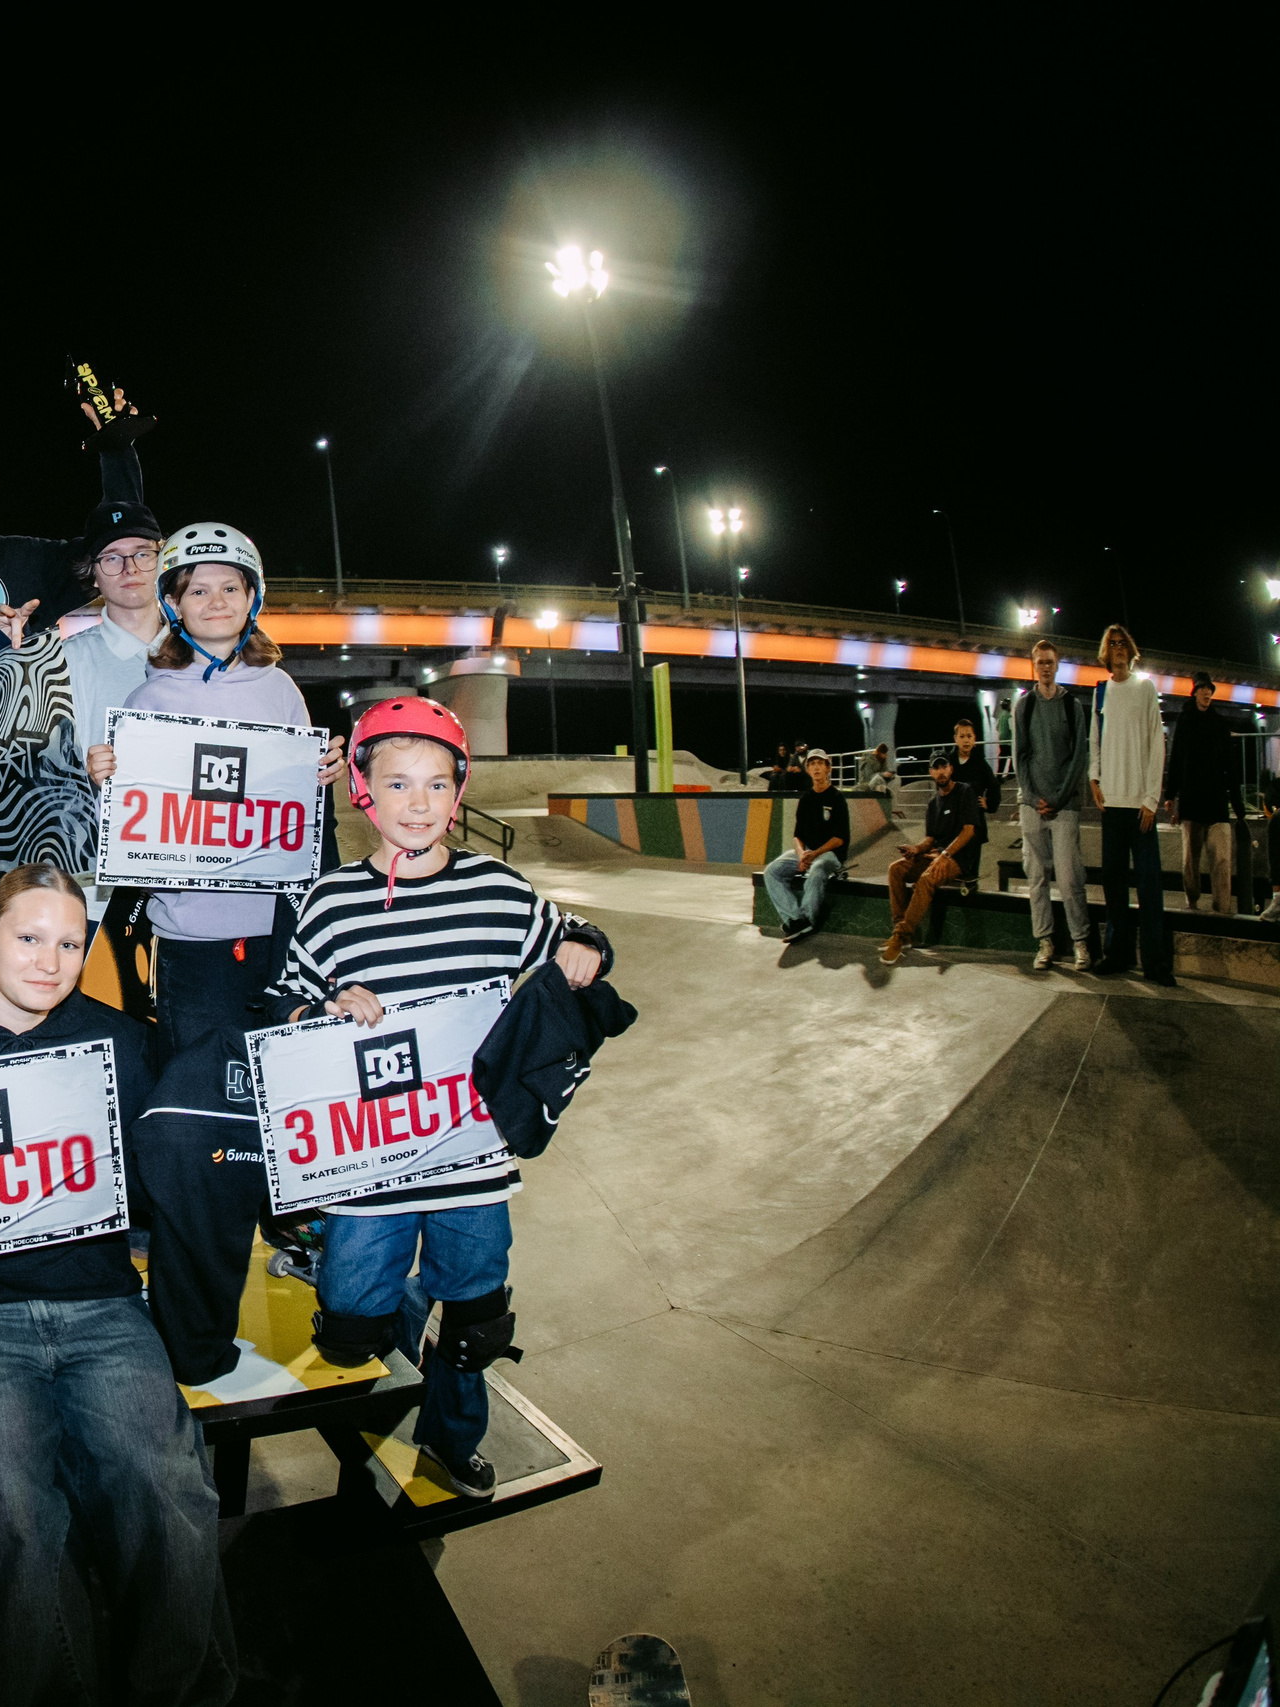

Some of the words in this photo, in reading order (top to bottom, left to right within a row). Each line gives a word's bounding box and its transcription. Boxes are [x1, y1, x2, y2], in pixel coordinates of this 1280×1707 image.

[111, 511, 123, 524] P
[198, 754, 241, 793] DC
[120, 789, 149, 843] 2
[159, 792, 306, 852] МЕСТО
[127, 851, 187, 863] SKATEGIRLS
[363, 1041, 415, 1090] DC
[284, 1108, 319, 1165] 3
[301, 1160, 369, 1182] SKATEGIRLS
